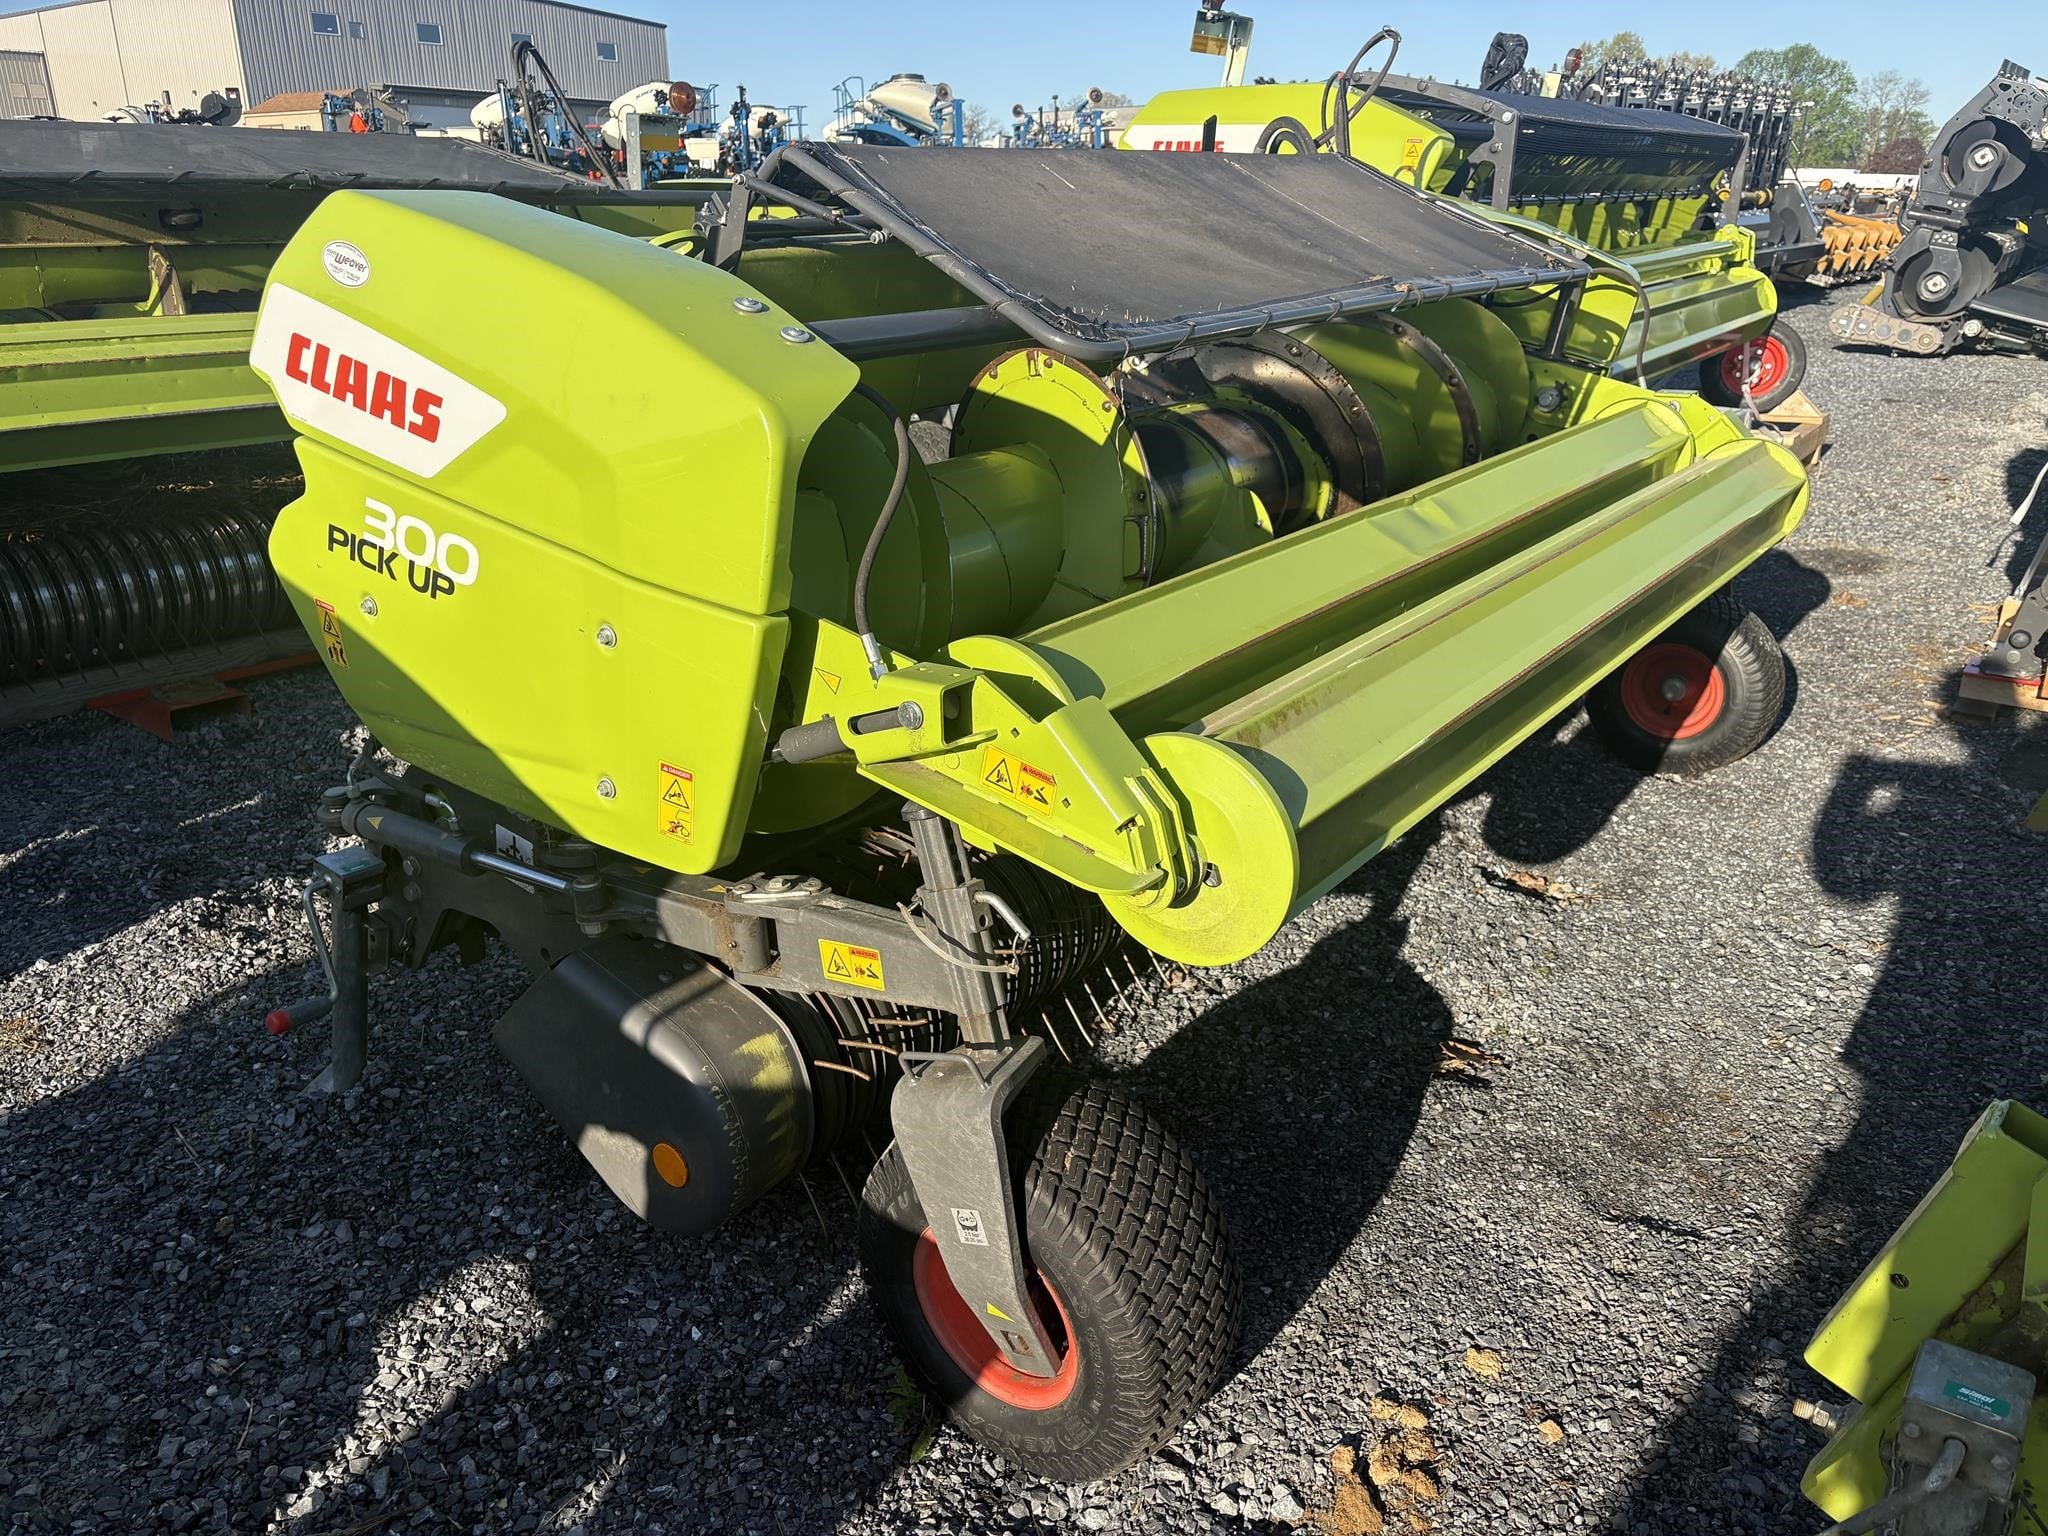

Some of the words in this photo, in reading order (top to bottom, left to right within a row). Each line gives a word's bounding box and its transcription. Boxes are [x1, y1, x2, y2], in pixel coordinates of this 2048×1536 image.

[334, 253, 368, 272] Weaver
[286, 332, 443, 443] CLAAS
[328, 523, 399, 581] PICK
[408, 559, 455, 600] UP
[363, 496, 479, 586] 300
[1958, 1387, 1996, 1403] simol
